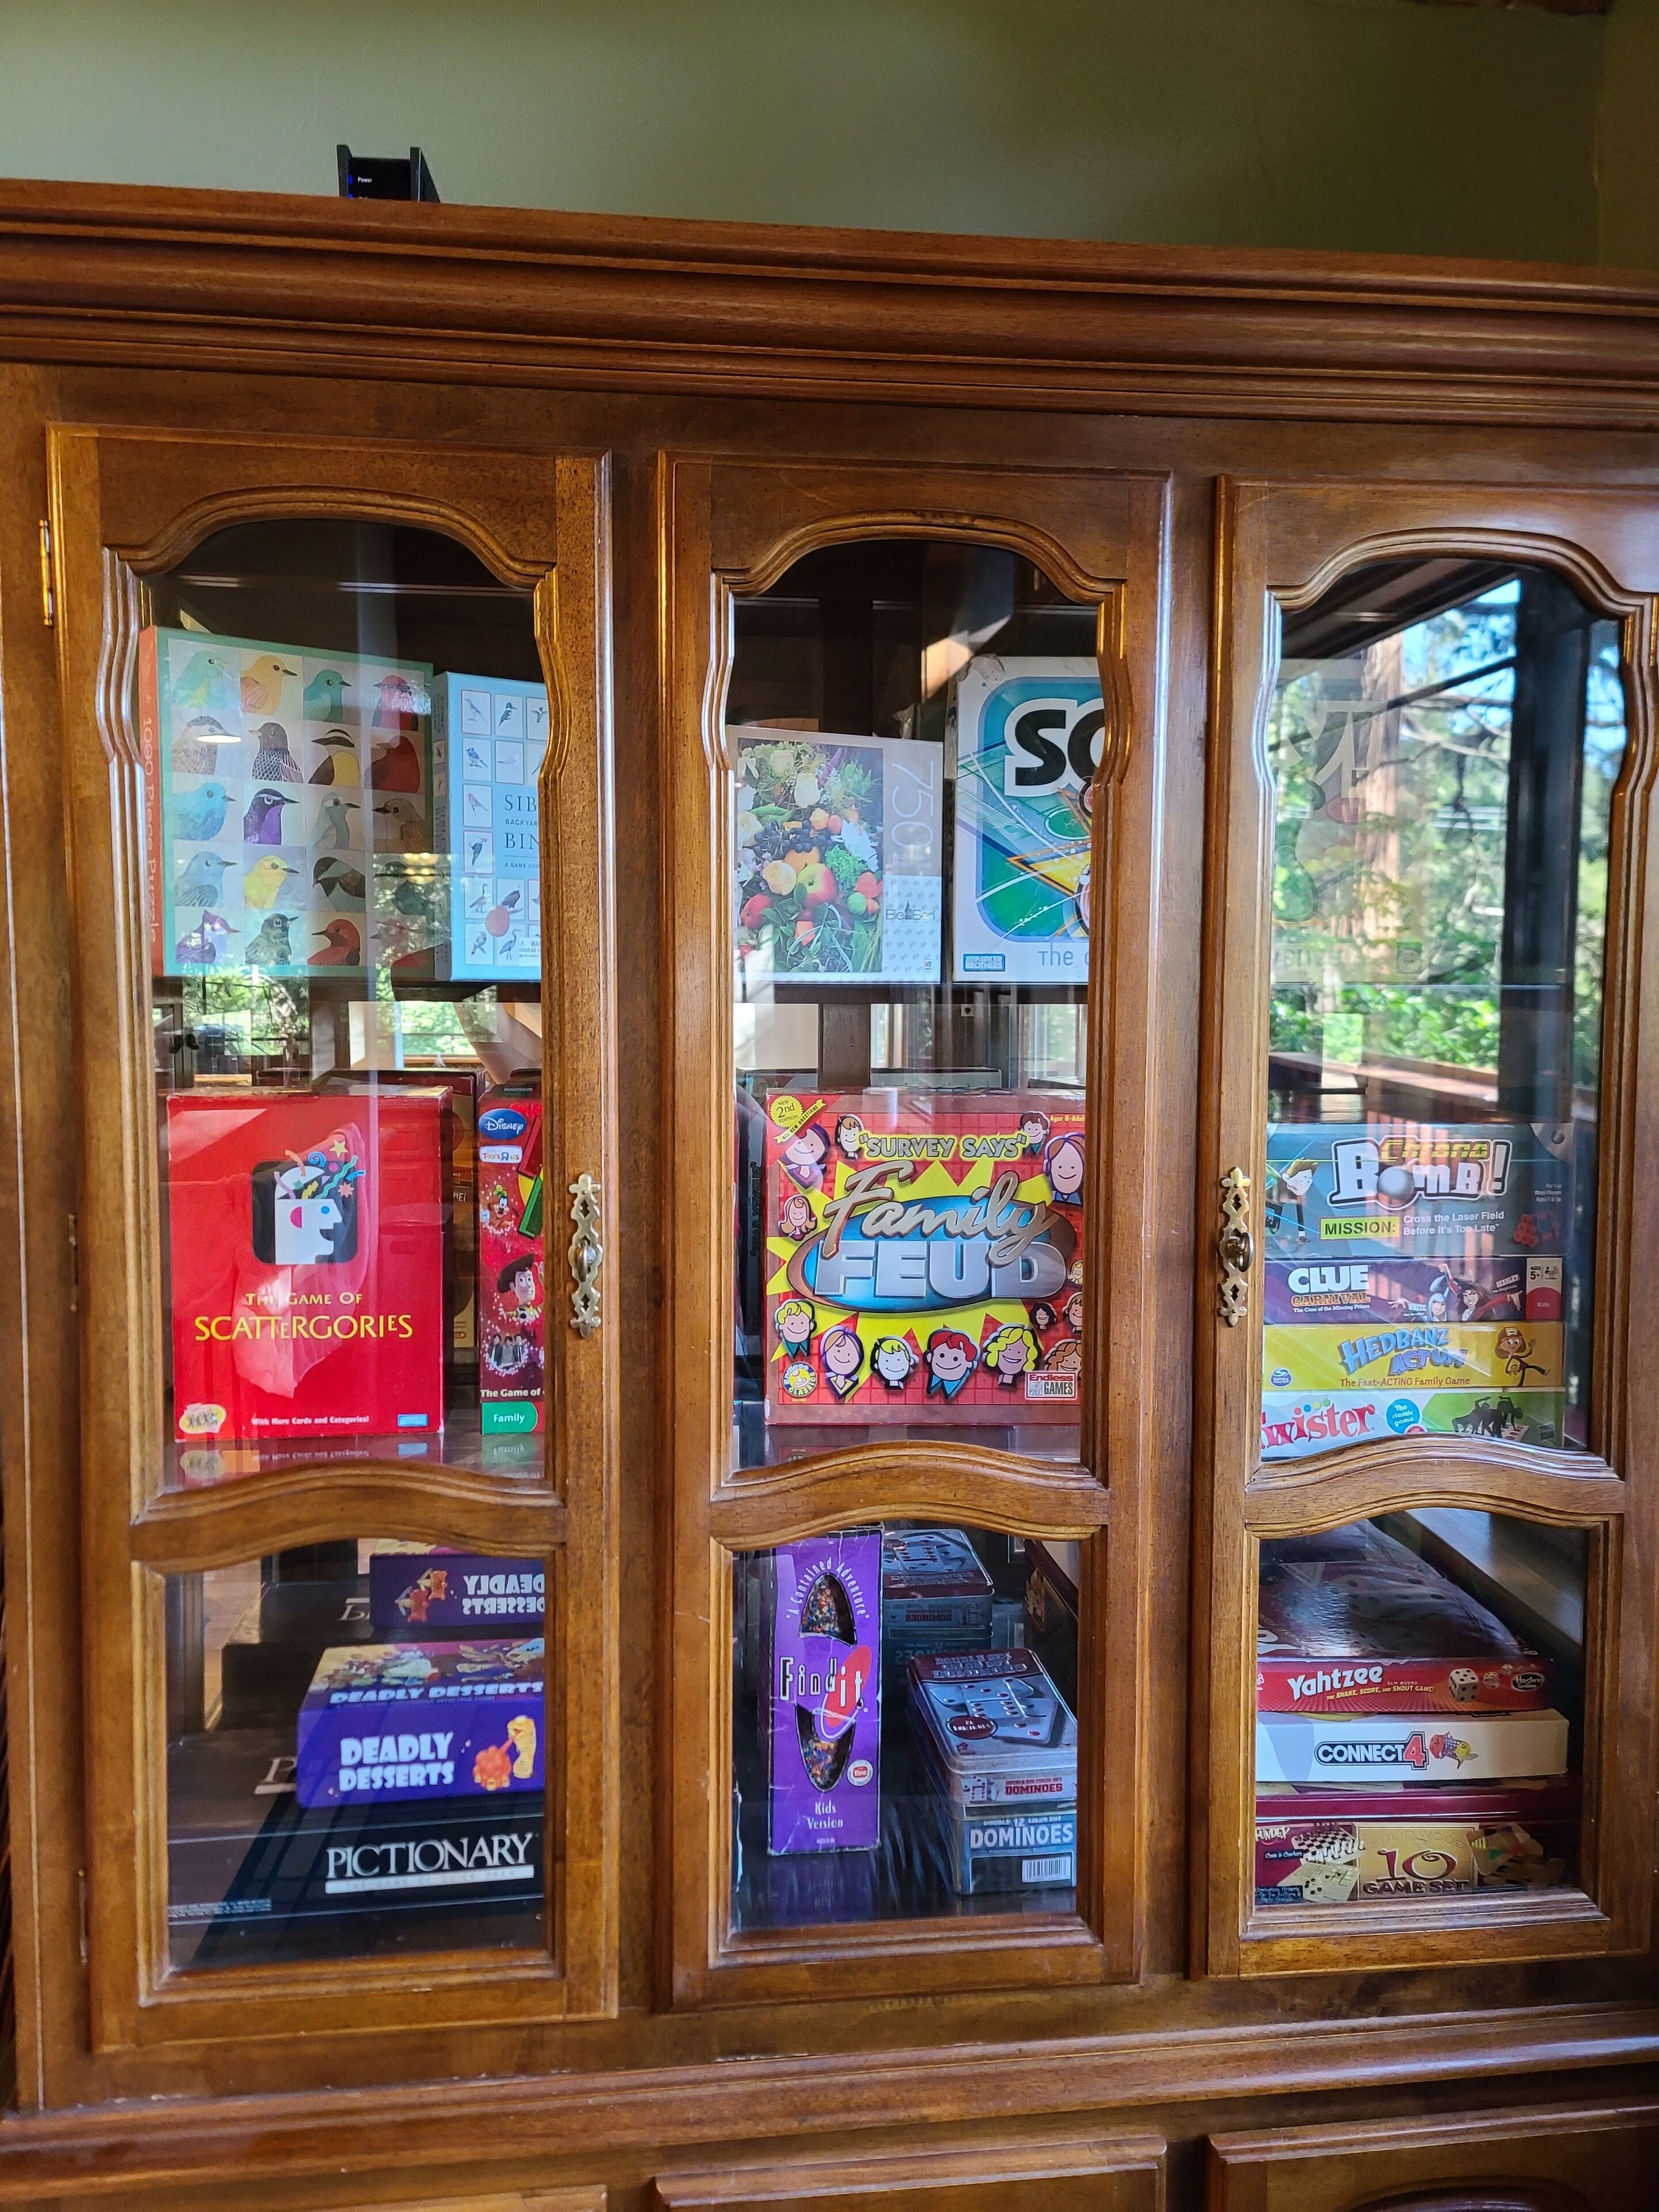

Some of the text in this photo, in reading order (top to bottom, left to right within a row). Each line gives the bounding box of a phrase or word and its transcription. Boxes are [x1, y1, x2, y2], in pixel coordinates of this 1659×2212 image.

[143, 717, 153, 776] 1000
[505, 794, 537, 812] SIB
[891, 760, 934, 849] 750
[1038, 943, 1074, 966] The
[776, 1103, 796, 1118] 2nd
[779, 1115, 798, 1123] EDITION
[823, 1160, 1061, 1266] Family
[1403, 1211, 1504, 1224] Cross the Laser Field
[1324, 1221, 1396, 1235] MISSION:
[1403, 1226, 1435, 1236] Before
[1455, 1225, 1471, 1234] Too
[815, 1240, 1066, 1300] FEUD
[1530, 1271, 1540, 1280] 5+
[1288, 1264, 1369, 1294] CLUE
[286, 1292, 331, 1305] GAME
[339, 1291, 362, 1305] OF
[1291, 1292, 1370, 1307] CARNIVAL
[195, 1314, 413, 1341] SCATTERGORIES
[1339, 1327, 1451, 1375] HEDBANZ
[1388, 1349, 1430, 1376] ACT
[1044, 1381, 1073, 1395] GAMES
[1340, 1379, 1355, 1388] The
[1414, 1377, 1443, 1388] Family
[1445, 1377, 1470, 1385] Game
[480, 1387, 541, 1398] The Game of
[251, 1418, 270, 1426] With
[291, 1416, 312, 1425] Cards
[314, 1416, 328, 1424] and
[493, 1413, 525, 1424] Family
[1392, 1410, 1413, 1419] classic
[1394, 1417, 1414, 1427] game
[1262, 1403, 1376, 1449] wister
[790, 1556, 831, 1604] Contained
[780, 1656, 863, 1709] Find it
[1287, 1666, 1384, 1701] Yahtzee
[329, 1682, 544, 1703] DEADLY DESSERTS
[340, 1732, 454, 1766] DEADLY
[1318, 1735, 1426, 1767] CONNECT 4
[339, 1761, 454, 1792] DESSERTS
[1005, 1783, 1063, 1795] DOMINOES
[815, 1798, 836, 1815] Kids
[807, 1816, 843, 1830] Version
[1014, 1817, 1025, 1827] 12
[970, 1823, 1073, 1849] DOMINOES
[1255, 1826, 1290, 1842] FUNDEX
[326, 1832, 533, 1879] PICTIONARY
[1376, 1848, 1459, 1880] 10
[1363, 1878, 1469, 1895] GAME SET
